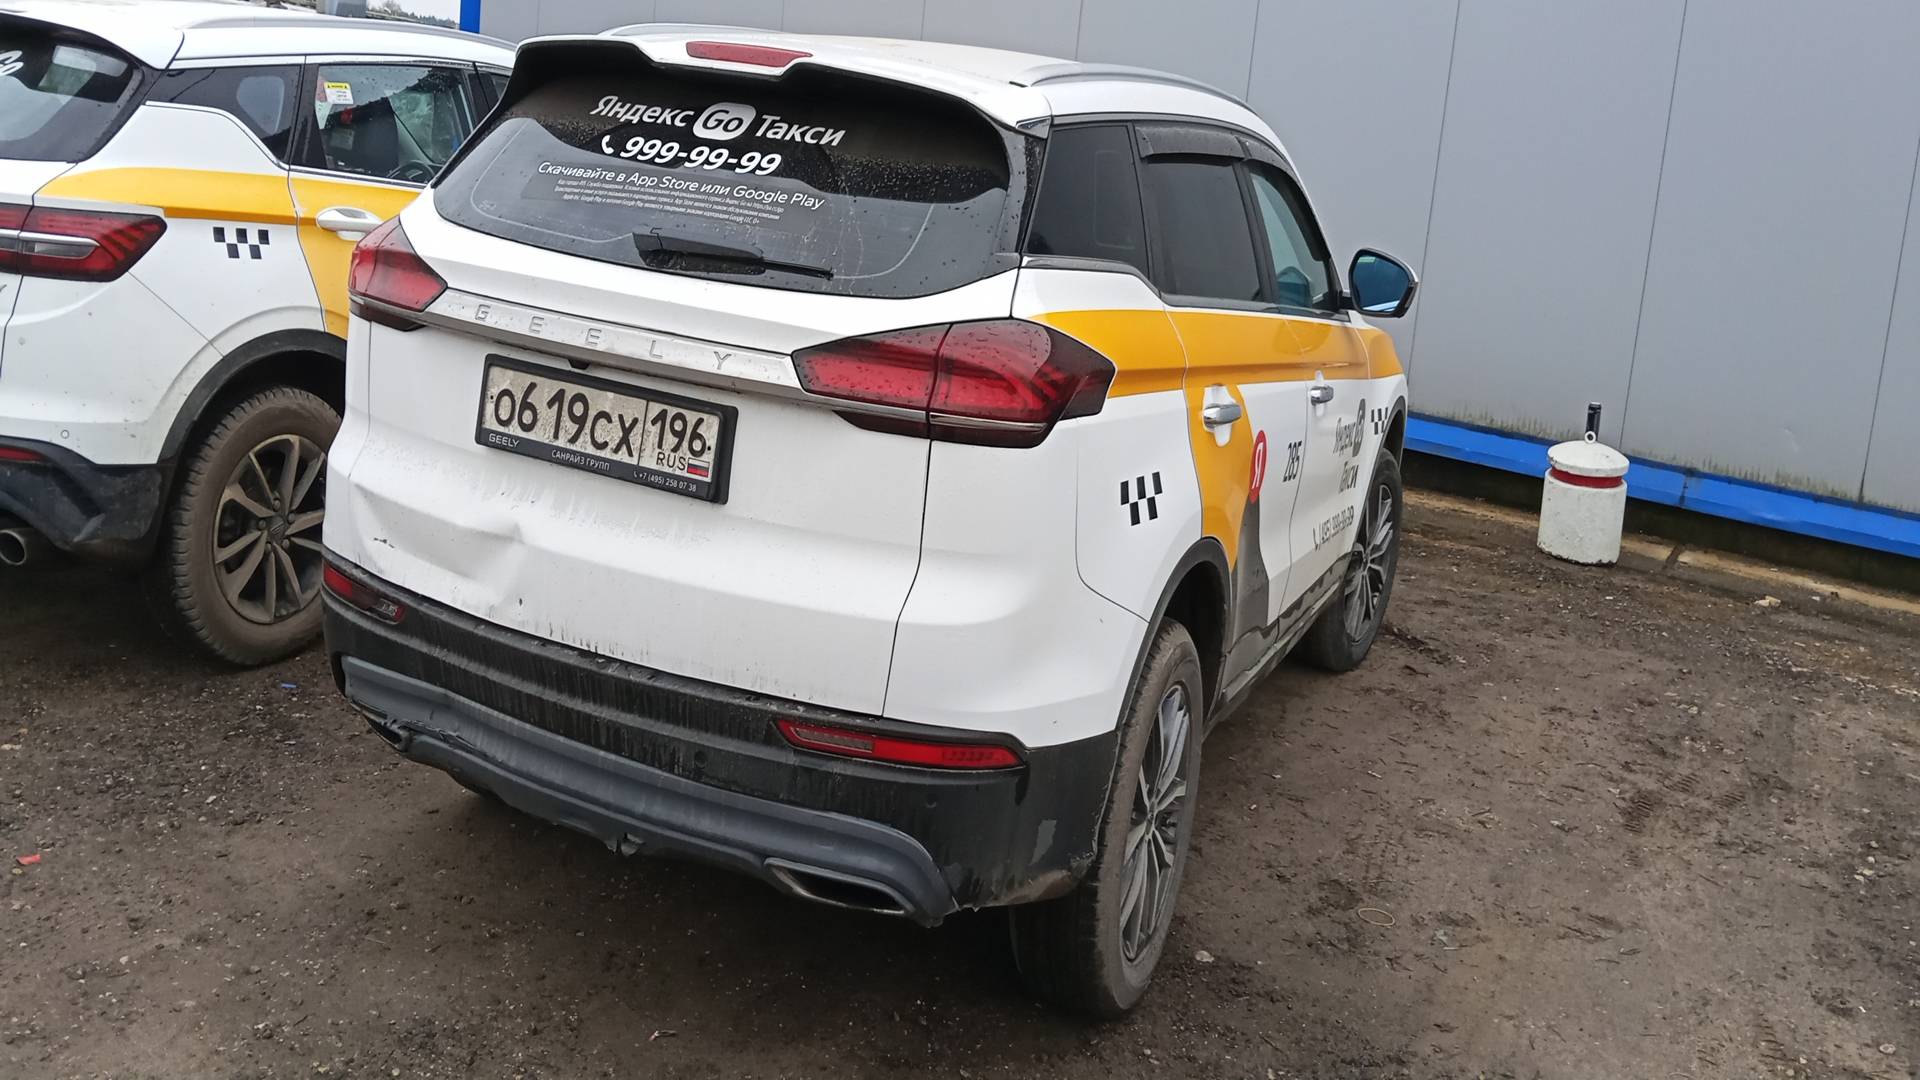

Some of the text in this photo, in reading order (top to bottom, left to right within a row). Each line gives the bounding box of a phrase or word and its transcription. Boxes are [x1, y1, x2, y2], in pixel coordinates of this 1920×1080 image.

[590, 95, 695, 127] Яндекс
[756, 115, 846, 146] Такси
[620, 136, 782, 176] 999-99-99
[538, 162, 616, 181] Скачивайте
[616, 173, 626, 182] в
[627, 173, 657, 187] App
[658, 176, 699, 191] Store
[700, 183, 731, 196] или
[733, 185, 788, 204] Google
[790, 192, 825, 210] Play
[474, 304, 732, 370] GEELY
[489, 433, 520, 448] GEELY
[651, 409, 707, 457] 196
[551, 449, 610, 471] САНРАЙЗ ГРУПП
[656, 451, 687, 471] RUS
[1252, 441, 1264, 490] Я
[1283, 440, 1303, 483] 285
[648, 473, 664, 485] (495)
[665, 477, 678, 488] 258
[679, 480, 687, 489] 07
[688, 483, 697, 492] 38
